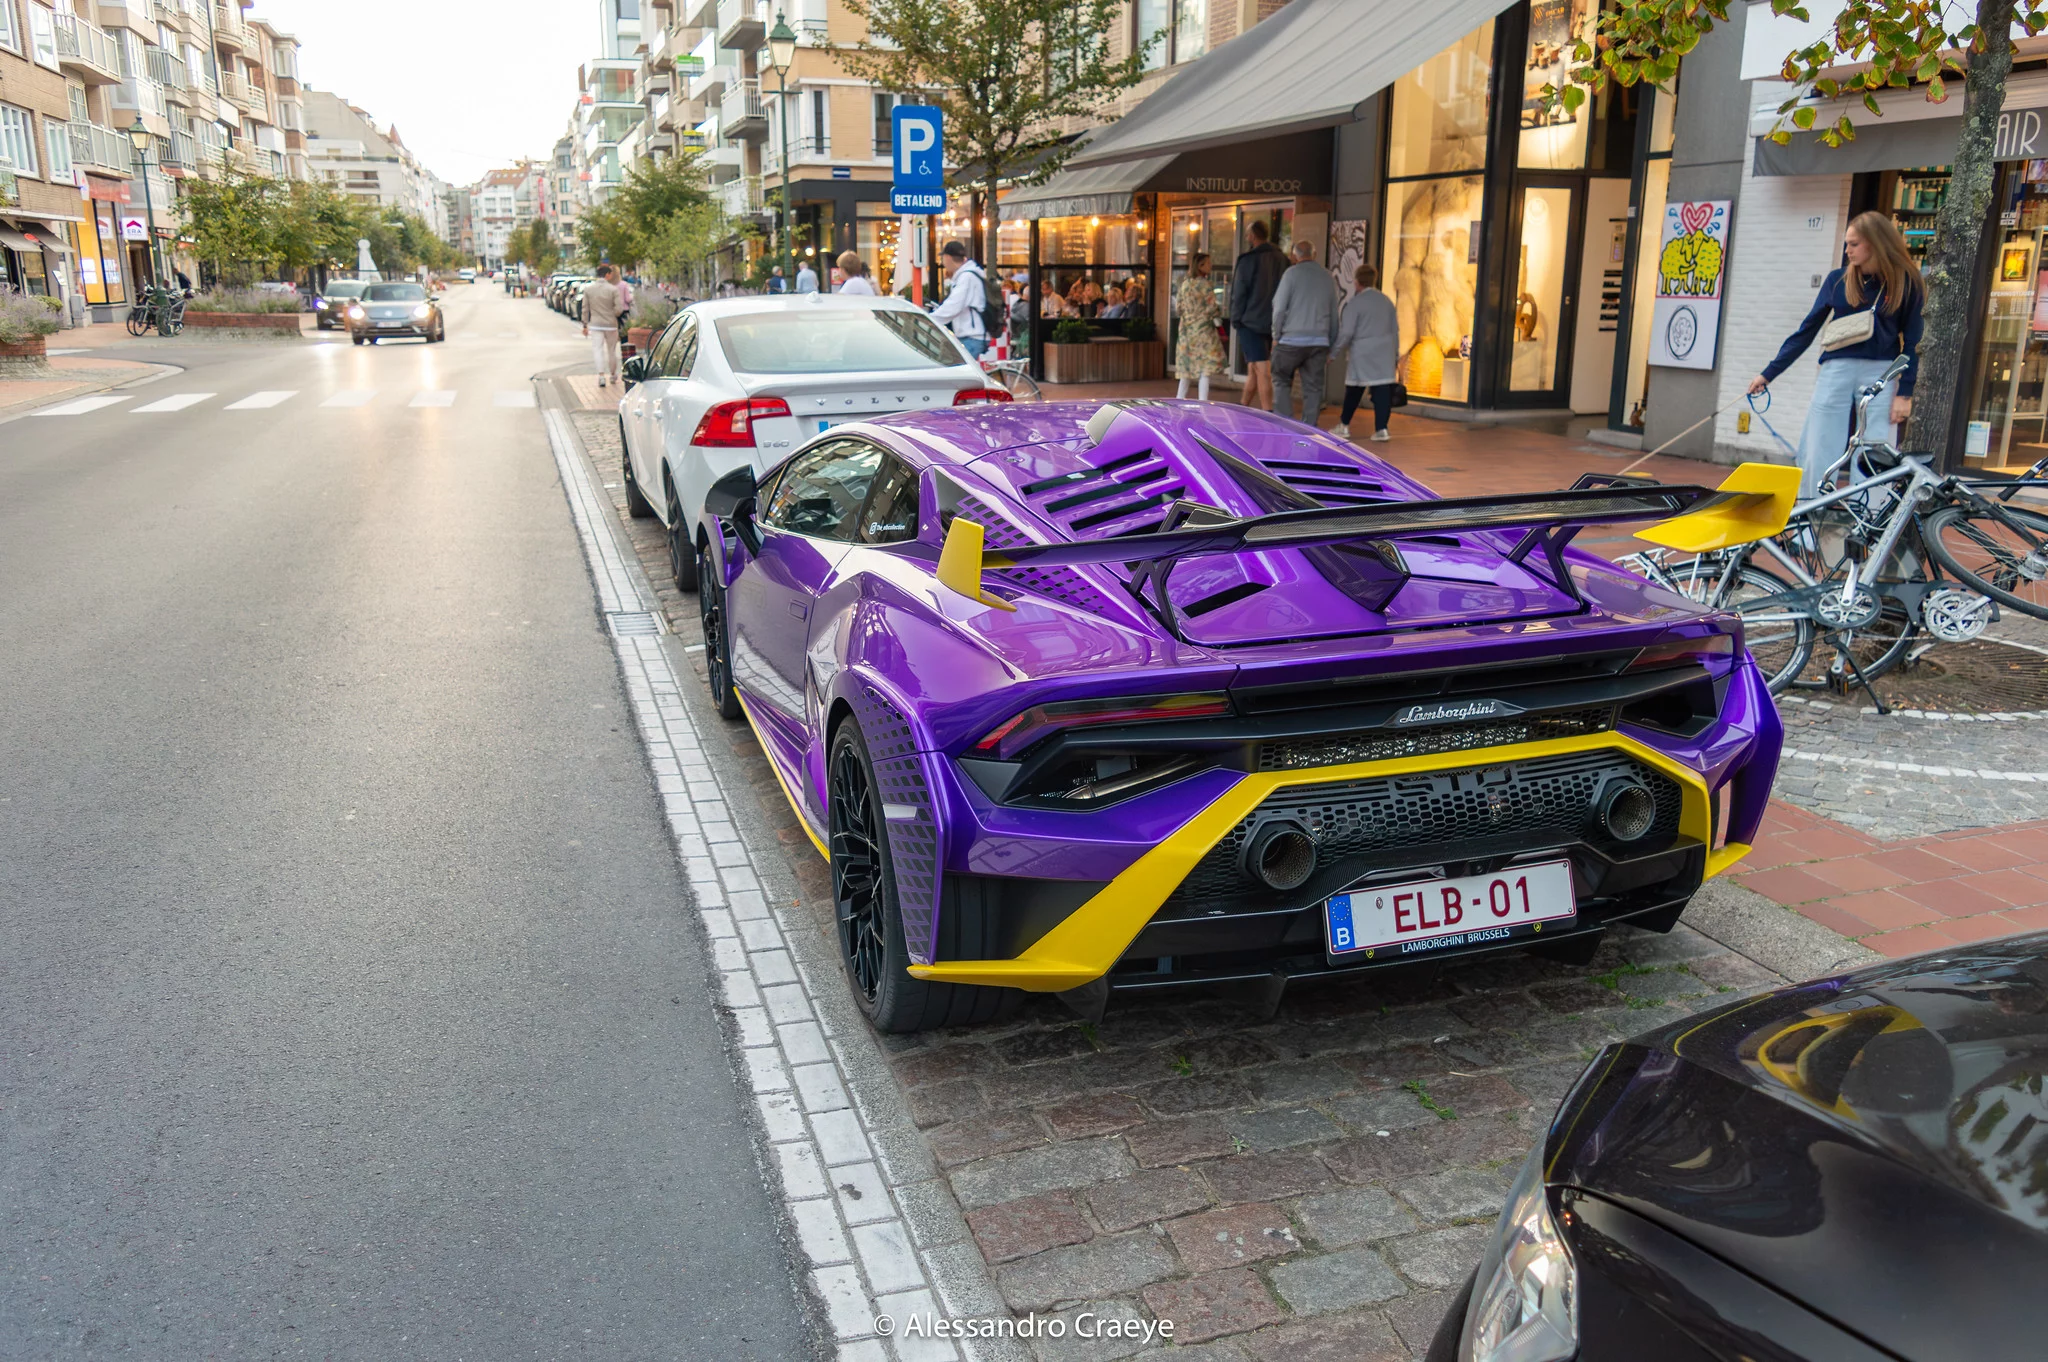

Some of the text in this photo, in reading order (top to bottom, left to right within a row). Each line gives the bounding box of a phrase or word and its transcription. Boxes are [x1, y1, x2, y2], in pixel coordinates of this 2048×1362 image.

[900, 118, 935, 174] P
[1186, 177, 1301, 192] INSTITUUT PODOR
[894, 194, 942, 207] BETALEND
[1808, 216, 1821, 228] 117
[816, 396, 930, 406] VOLVO
[763, 440, 789, 448] S60
[1400, 701, 1496, 723] Lamborghini
[1392, 875, 1530, 934] ELB-01
[1336, 927, 1350, 946] B
[1401, 927, 1510, 953] LAMBORGHINI BRUSSELS
